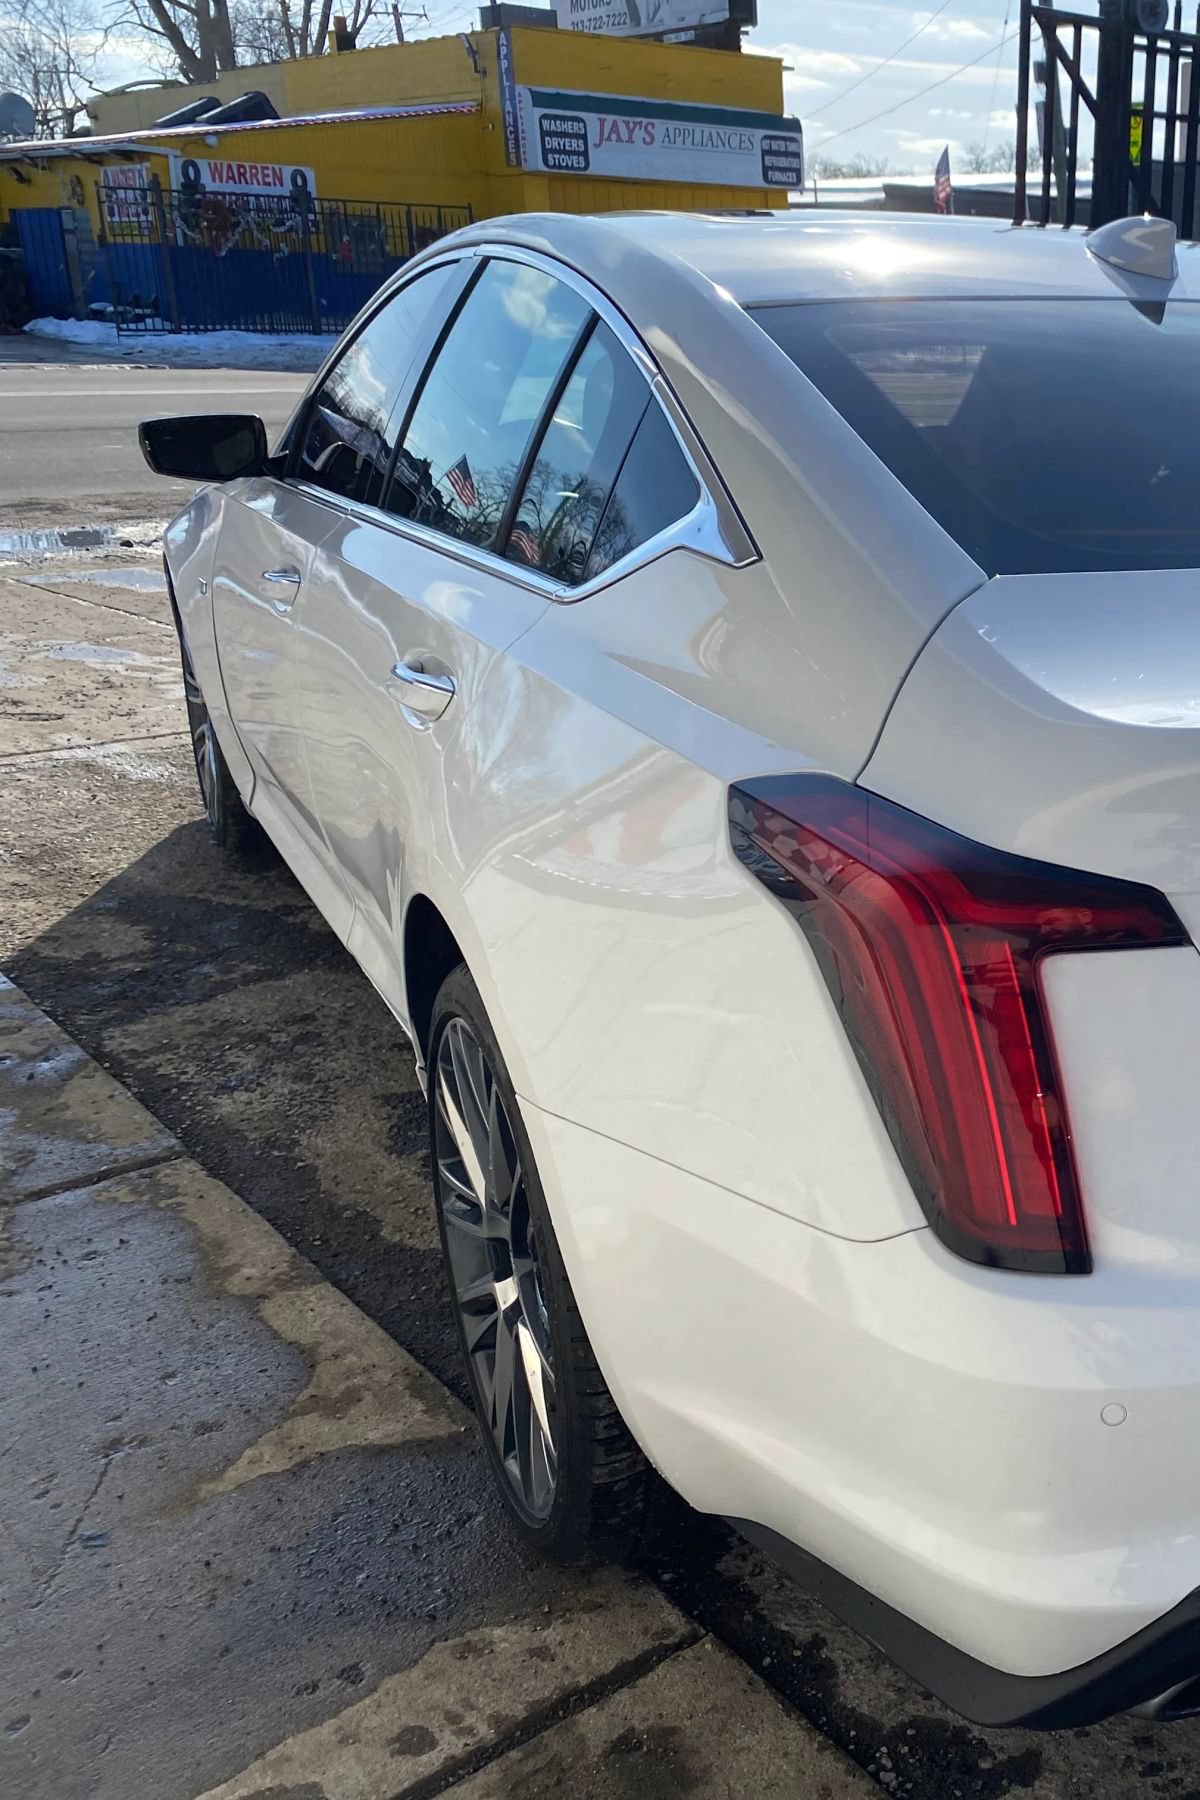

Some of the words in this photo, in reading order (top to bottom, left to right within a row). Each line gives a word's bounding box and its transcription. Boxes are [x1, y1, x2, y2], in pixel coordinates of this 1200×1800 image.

[499, 31, 518, 166] APPLIANCES
[541, 119, 585, 135] WASHERS
[593, 117, 655, 149] JAY'S
[660, 126, 755, 152] APPLIANCES
[544, 136, 585, 152] DRYERS
[547, 154, 585, 168] STOVES
[207, 161, 284, 188] WARREN
